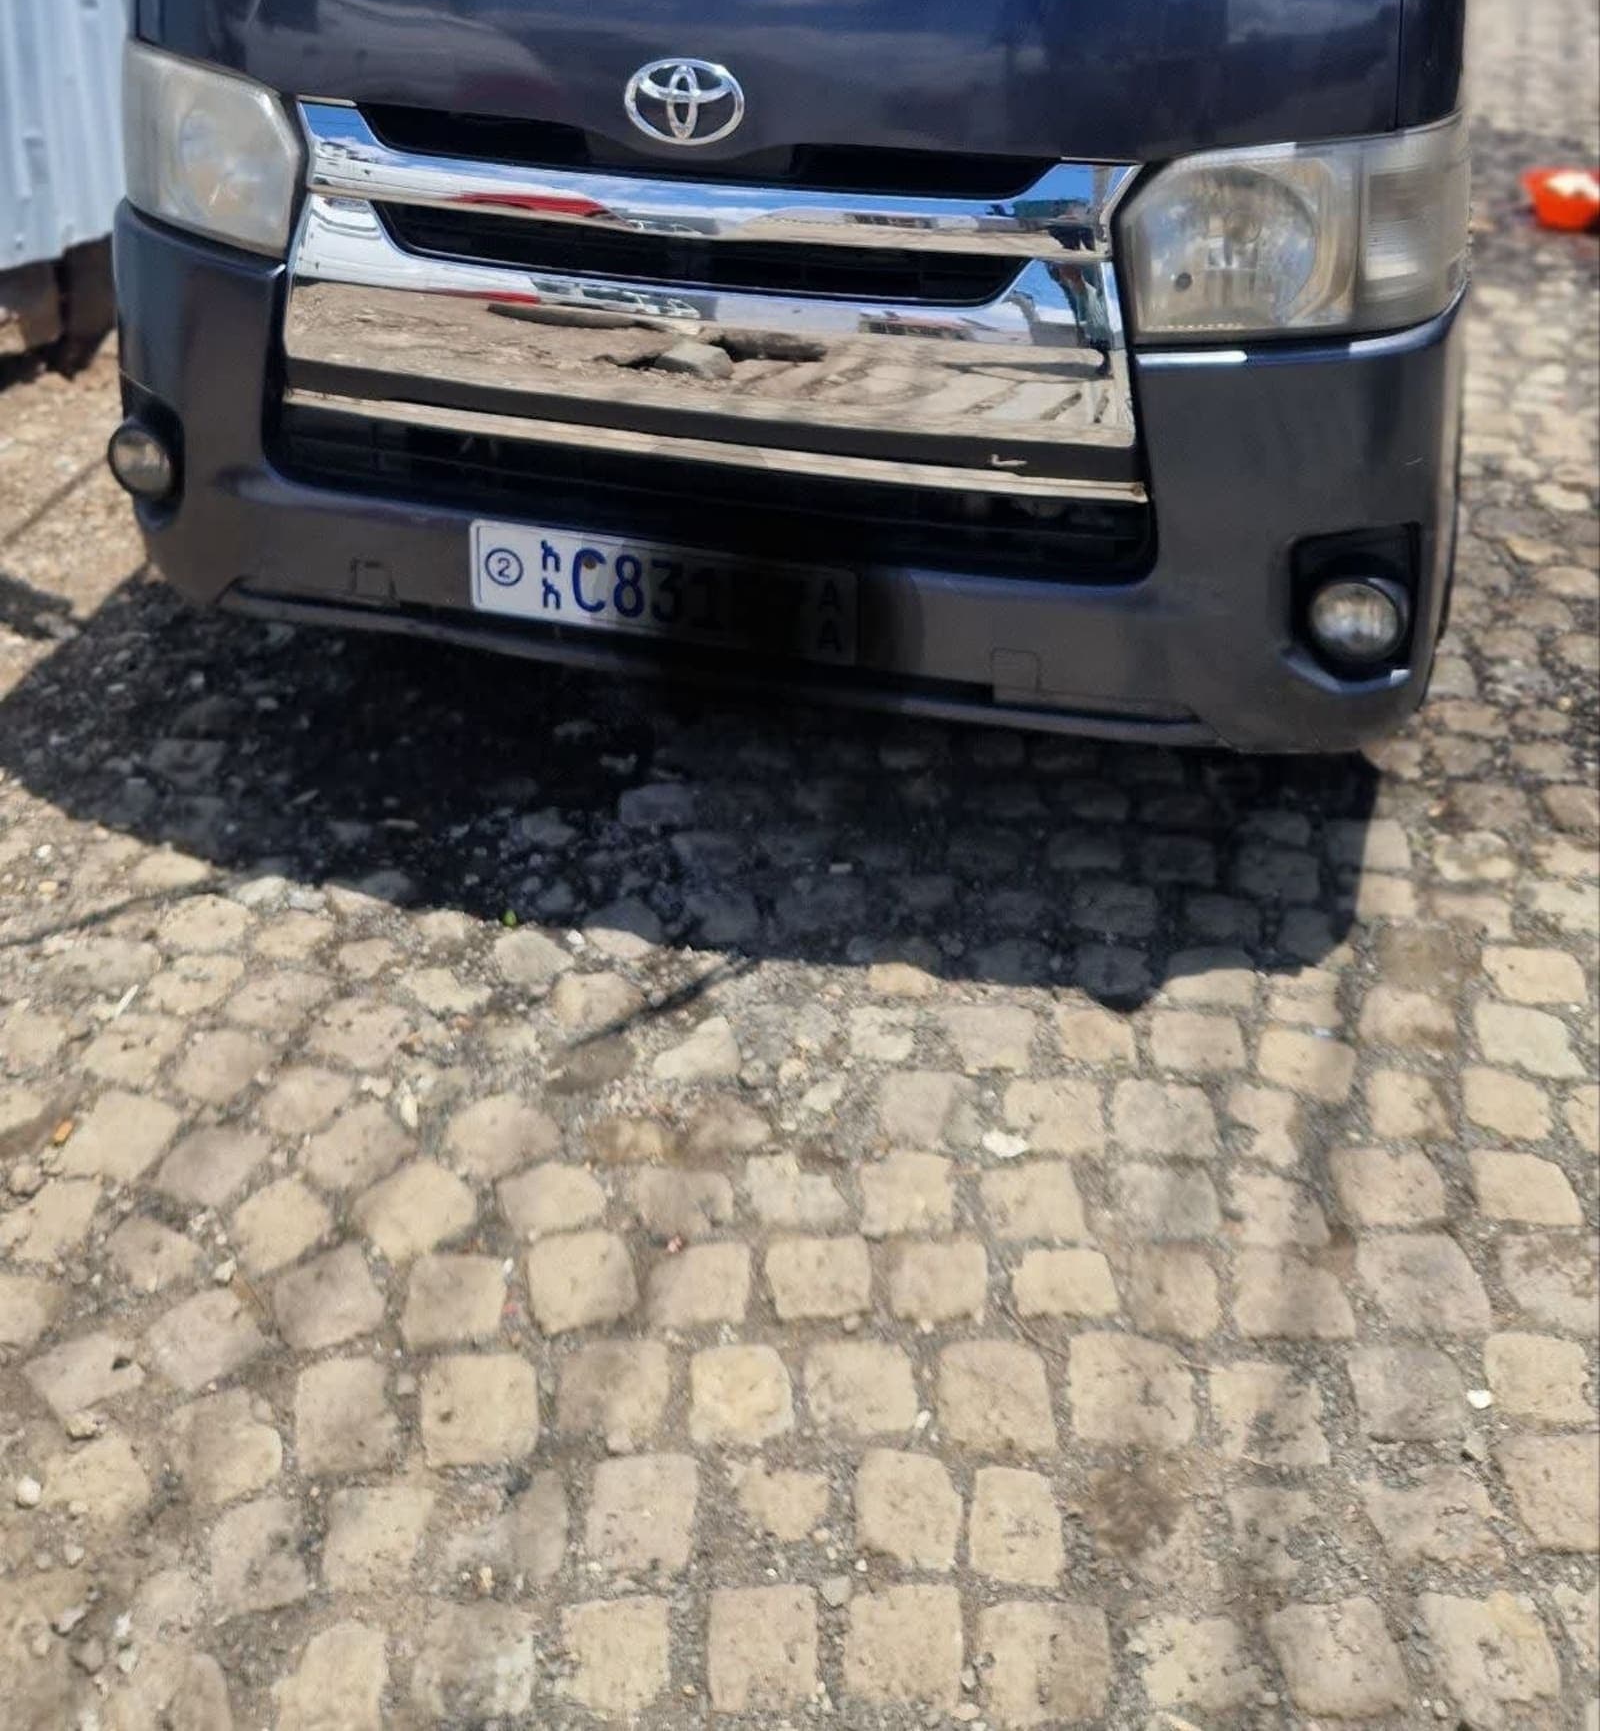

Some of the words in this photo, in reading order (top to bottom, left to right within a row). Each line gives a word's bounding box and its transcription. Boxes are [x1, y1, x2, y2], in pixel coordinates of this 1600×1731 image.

[497, 557, 511, 579] 2
[572, 548, 790, 641] C831
[818, 579, 842, 614] A
[817, 618, 842, 653] A
